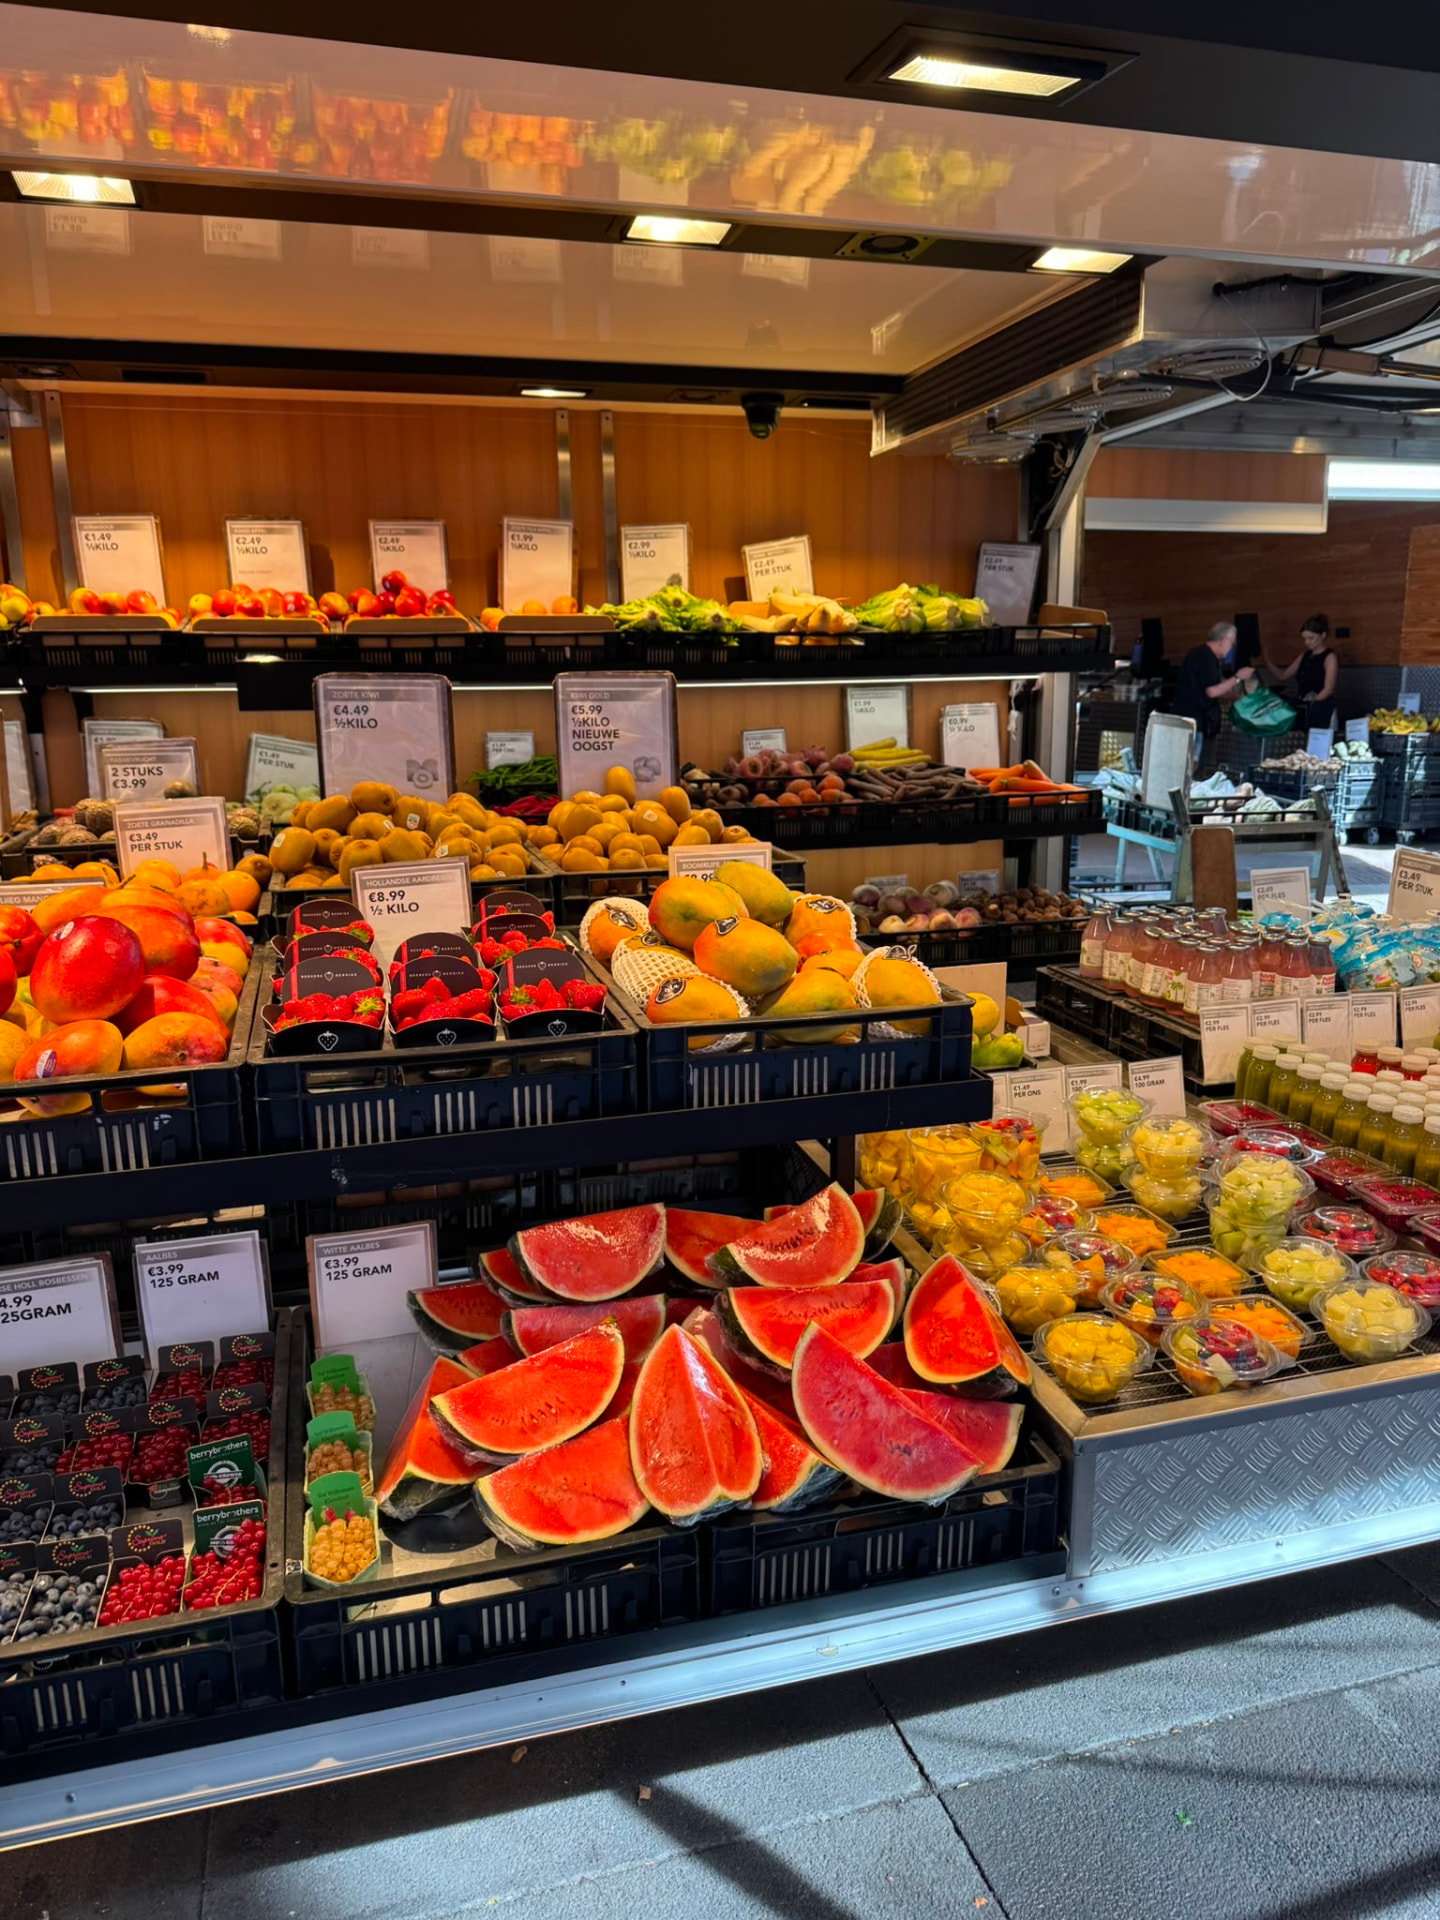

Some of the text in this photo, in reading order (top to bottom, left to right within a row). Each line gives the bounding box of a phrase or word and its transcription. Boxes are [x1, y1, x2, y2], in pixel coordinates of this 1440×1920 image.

[84, 533, 112, 541] €1.49
[236, 536, 262, 545] €2.49
[378, 537, 400, 545] €2.49
[510, 533, 534, 542] €1.99
[86, 542, 119, 551] ½KILO
[236, 546, 268, 555] ½KILO
[628, 541, 651, 550] €2.99
[754, 559, 775, 569] €2.49
[754, 563, 792, 577] PER STUK
[331, 691, 380, 699] ZOETE KIWI
[333, 704, 369, 716] €4.49
[571, 705, 602, 715] €5.99
[334, 718, 378, 729] ½KILO
[571, 717, 610, 727] ½KILO
[572, 729, 620, 739] NIEUWE
[572, 741, 615, 751] OOGST
[258, 758, 296, 769] PER STUK
[111, 766, 164, 777] 2 STUKS
[112, 779, 147, 789] €3.99
[127, 818, 196, 829] ZOETE GRANADILLA
[129, 832, 158, 842] €3.49
[130, 840, 183, 852] PER STUK
[1399, 869, 1421, 882] €3.49
[366, 878, 410, 887] HOLLANDSE
[1397, 879, 1434, 896] PER STUK
[368, 890, 406, 902] €8.99
[370, 902, 419, 916] ½ KILO
[1013, 1084, 1030, 1092] €1.49
[1146, 1079, 1165, 1087] GRAM
[322, 1241, 380, 1255] WITTE AALBES
[145, 1251, 178, 1262] AALBES
[324, 1257, 359, 1269] €3.99
[148, 1263, 184, 1277] €3.99
[326, 1264, 392, 1281] 125 GRAM
[0, 1274, 89, 1292] SE HOLL BOSBESSEN
[150, 1271, 220, 1288] 125 GRAM
[0, 1294, 33, 1309] 4.99
[0, 1303, 72, 1324] 25GRAM
[190, 1440, 248, 1460] berrybrothers
[196, 1506, 259, 1523] berrybrothers
